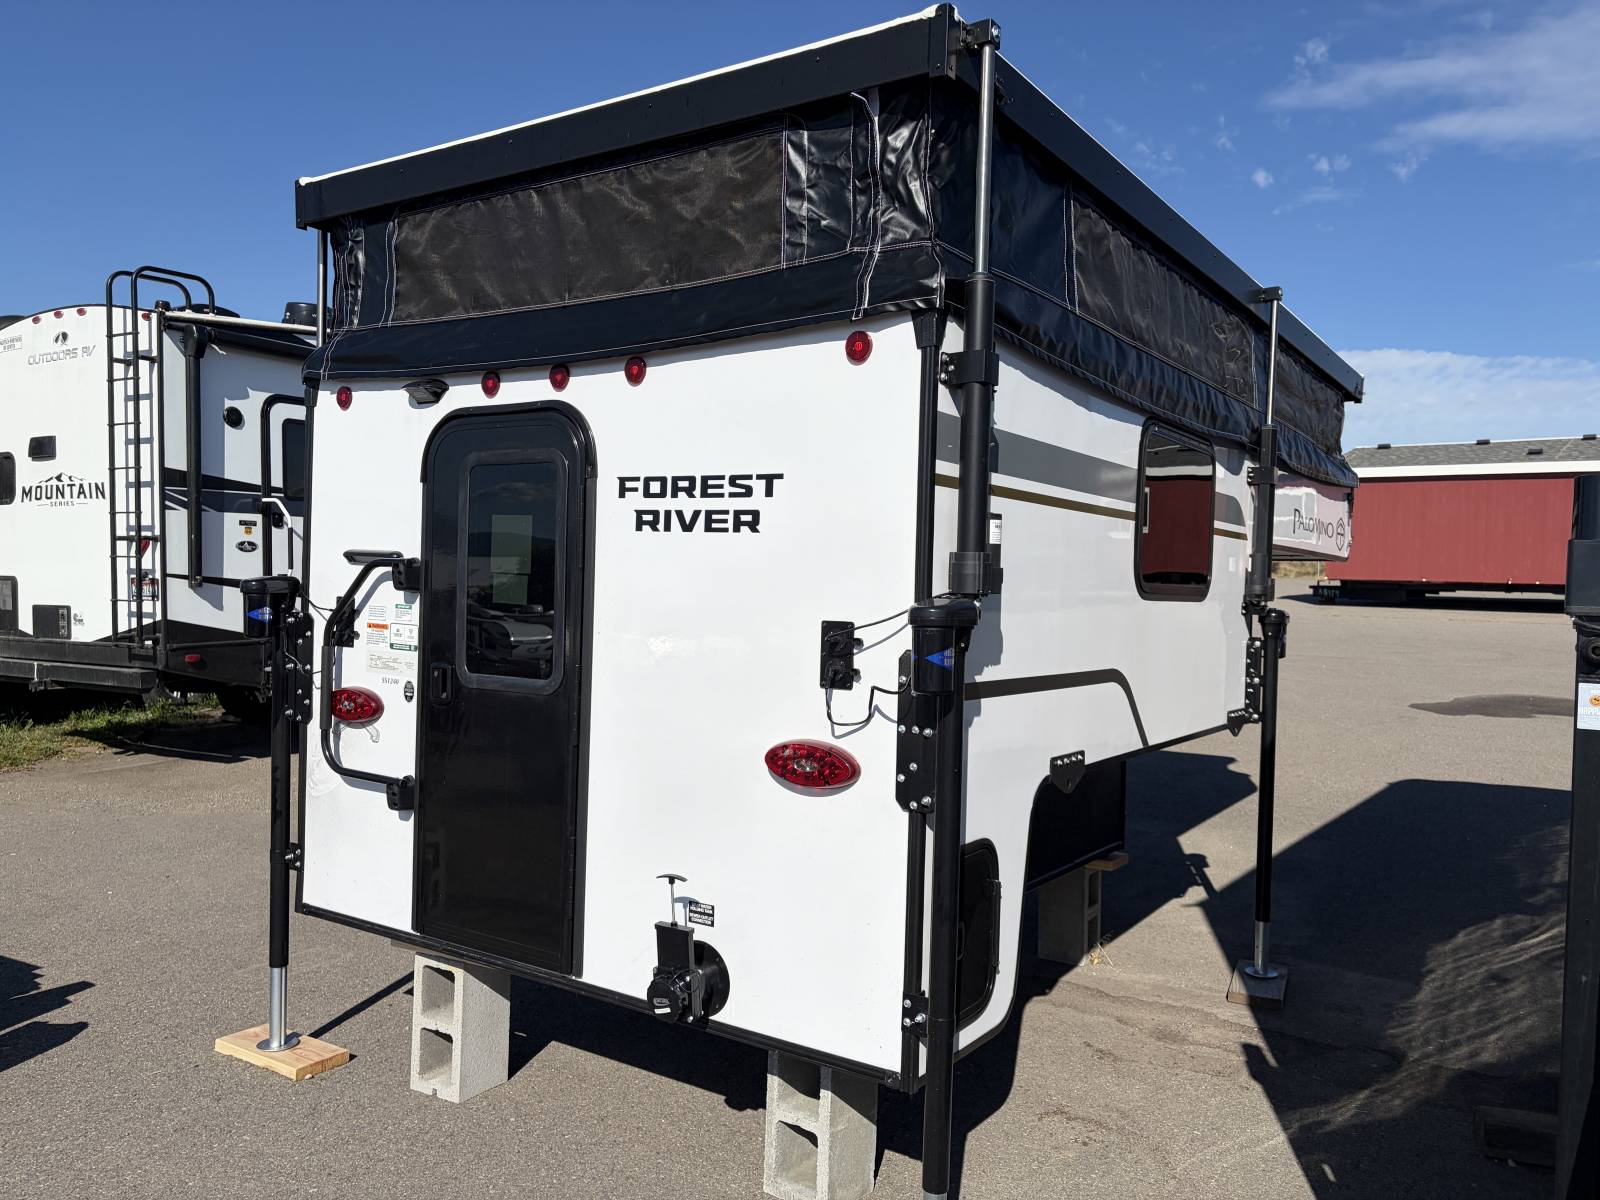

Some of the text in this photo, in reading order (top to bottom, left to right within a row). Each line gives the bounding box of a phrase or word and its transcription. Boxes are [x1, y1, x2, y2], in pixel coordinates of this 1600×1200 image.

[27, 344, 96, 366] OUTDOORS RV
[20, 481, 106, 503] MOUNTAIN
[616, 473, 785, 499] FOREST
[49, 500, 75, 508] SERIES
[633, 509, 761, 534] RIVER
